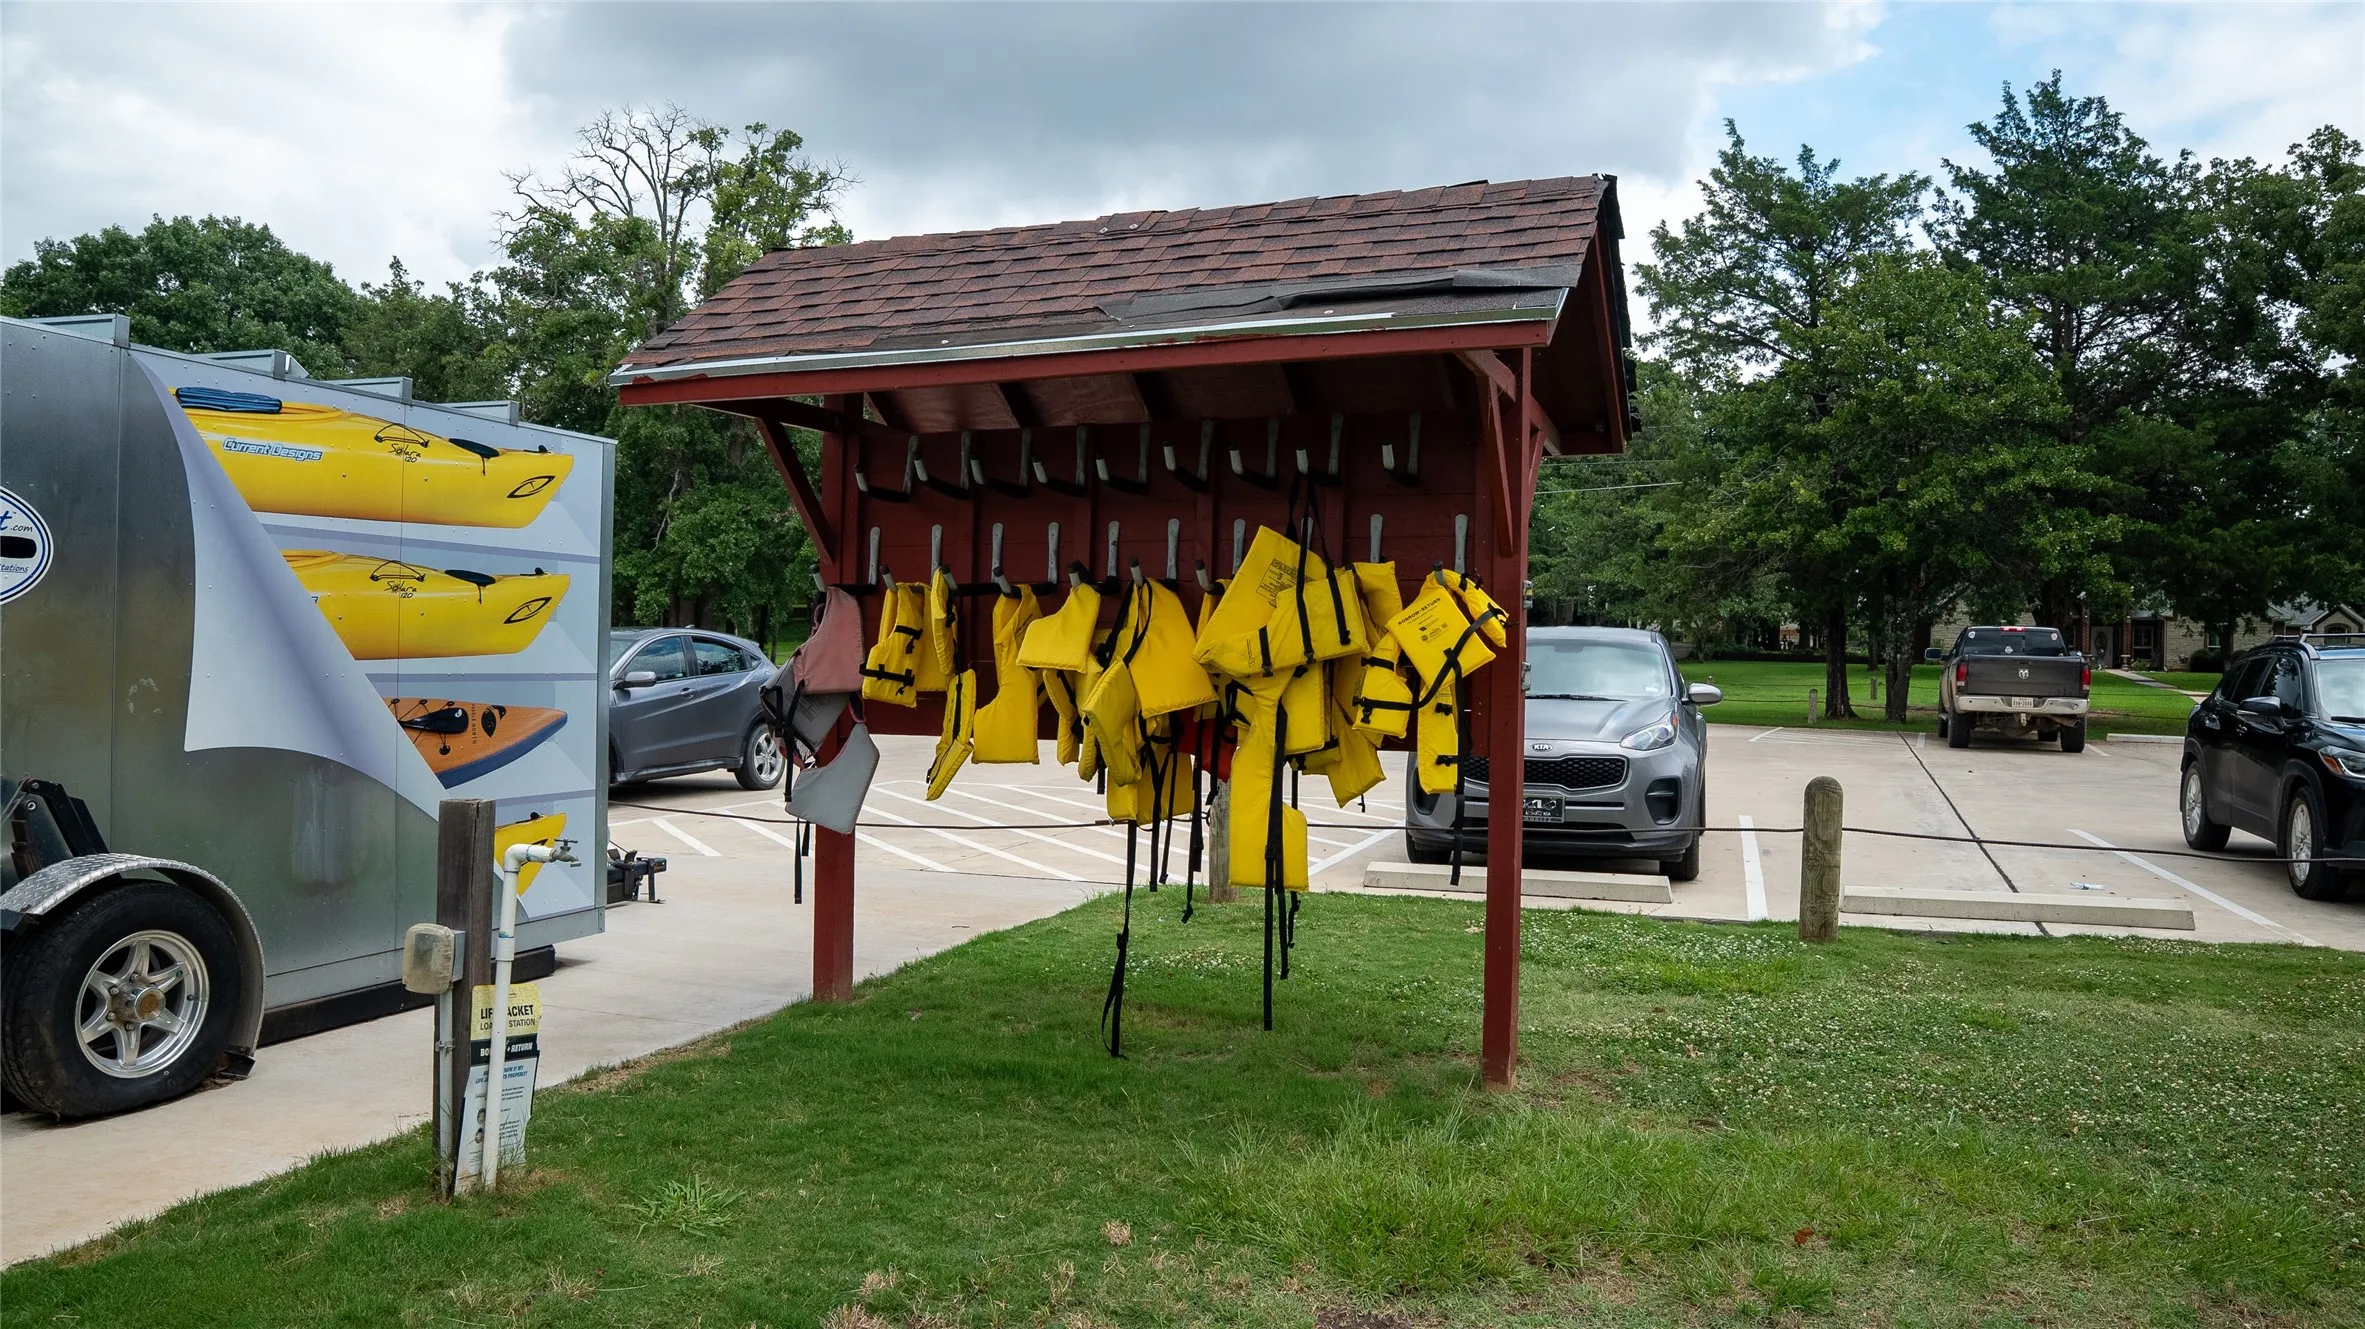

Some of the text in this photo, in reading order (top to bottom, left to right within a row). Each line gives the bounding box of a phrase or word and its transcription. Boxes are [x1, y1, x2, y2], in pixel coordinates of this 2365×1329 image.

[223, 437, 323, 461] Current Designs
[405, 455, 417, 463] 120
[0, 563, 29, 573] tations
[480, 1005, 533, 1020] LIF ACKET
[508, 1018, 536, 1028] STATION
[511, 1042, 533, 1052] RETURN
